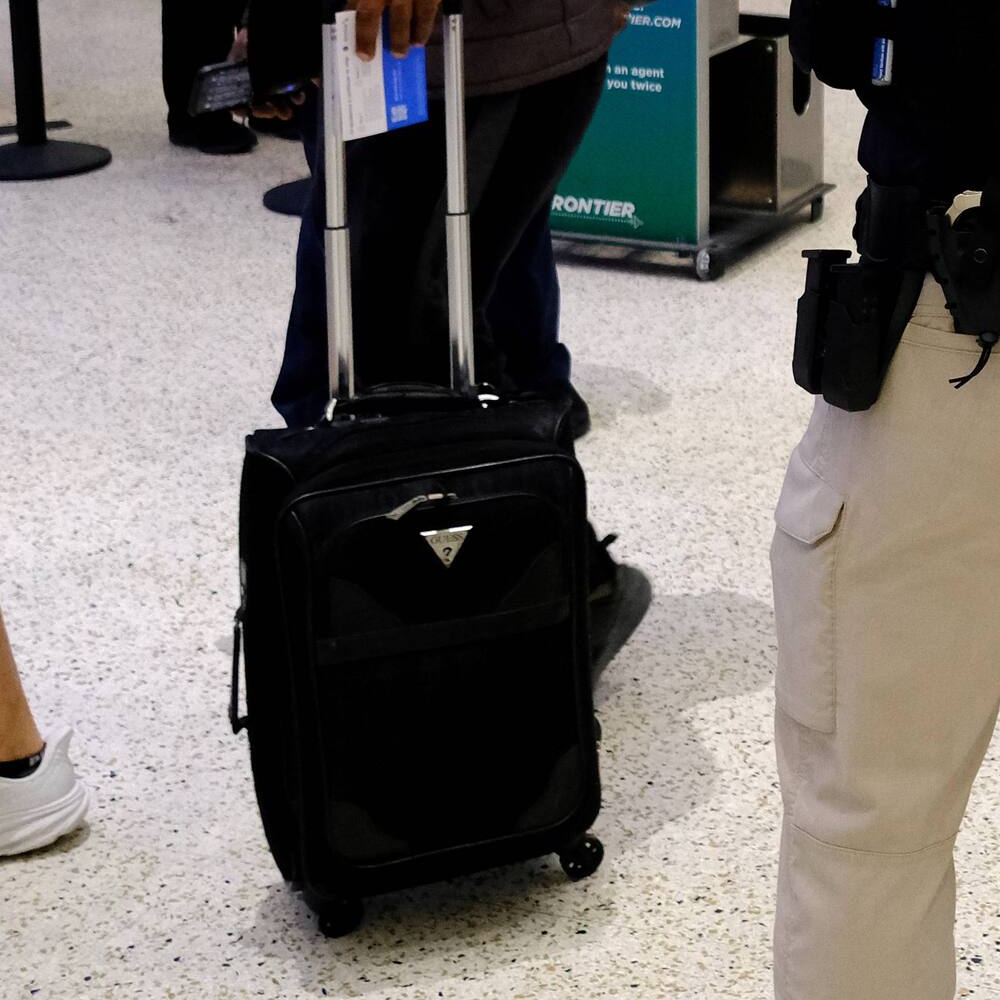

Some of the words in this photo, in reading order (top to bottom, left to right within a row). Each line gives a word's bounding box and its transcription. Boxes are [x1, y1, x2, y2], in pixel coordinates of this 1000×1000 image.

[625, 12, 682, 29] IER.COM
[614, 64, 628, 75] an
[631, 66, 664, 78] agent
[607, 79, 628, 90] you
[631, 80, 662, 93] twice
[551, 194, 635, 218] RONTIER
